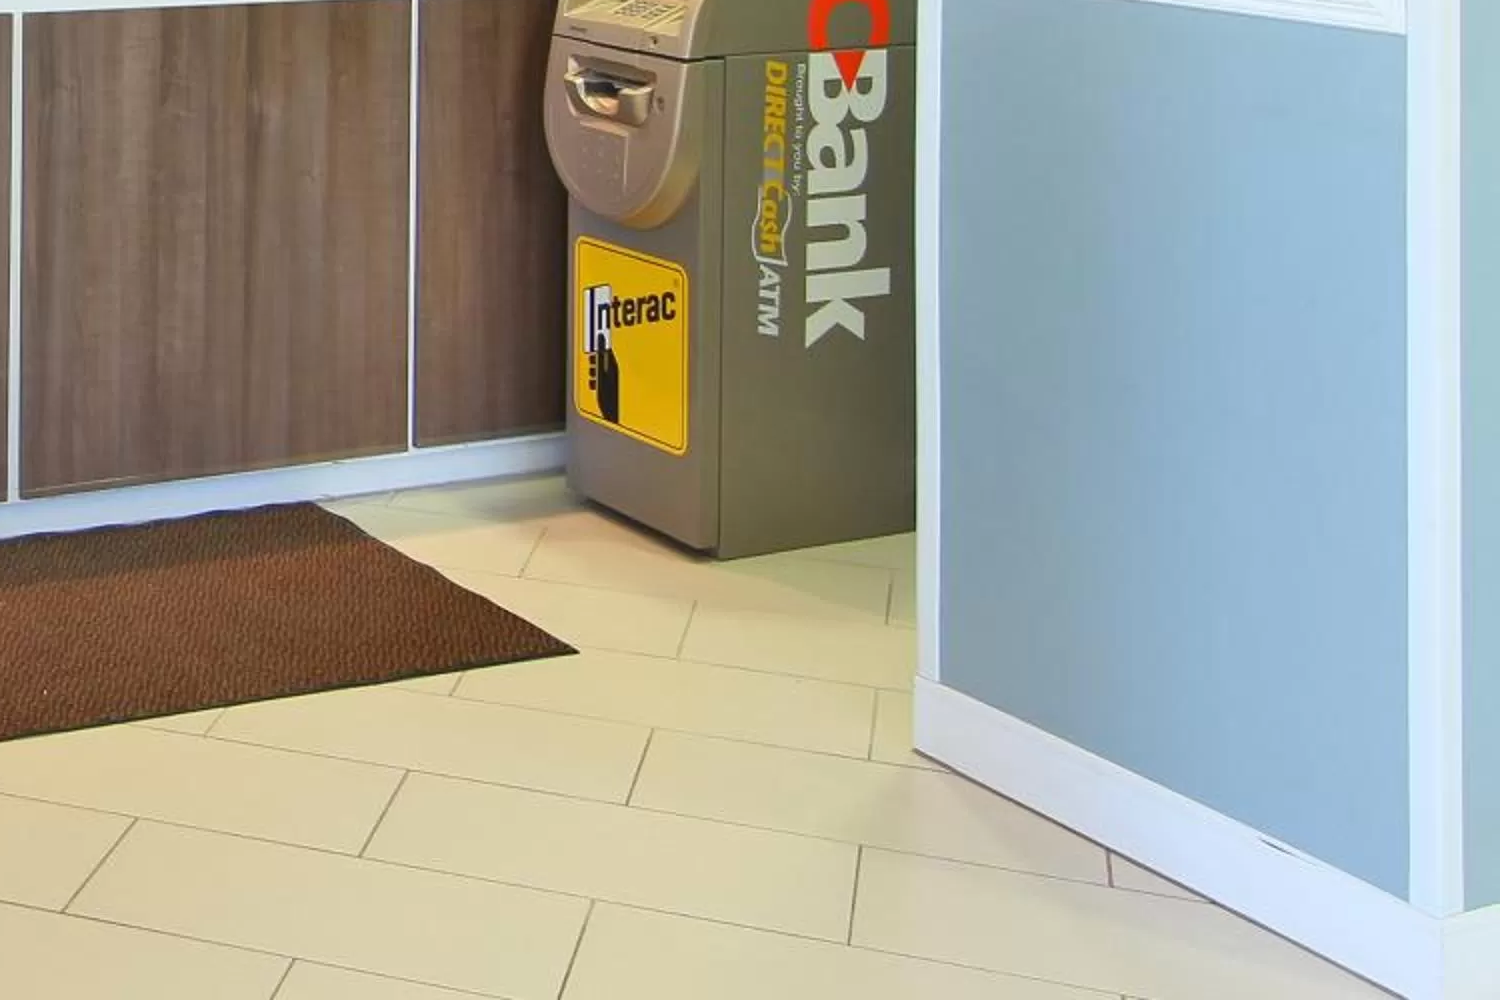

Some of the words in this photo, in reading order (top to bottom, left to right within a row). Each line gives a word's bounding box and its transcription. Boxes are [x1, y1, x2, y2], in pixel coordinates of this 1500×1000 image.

[794, 63, 806, 123] Brought
[791, 143, 804, 171] you
[794, 125, 805, 140] to
[585, 286, 677, 353] Interac
[757, 263, 781, 337] ATM
